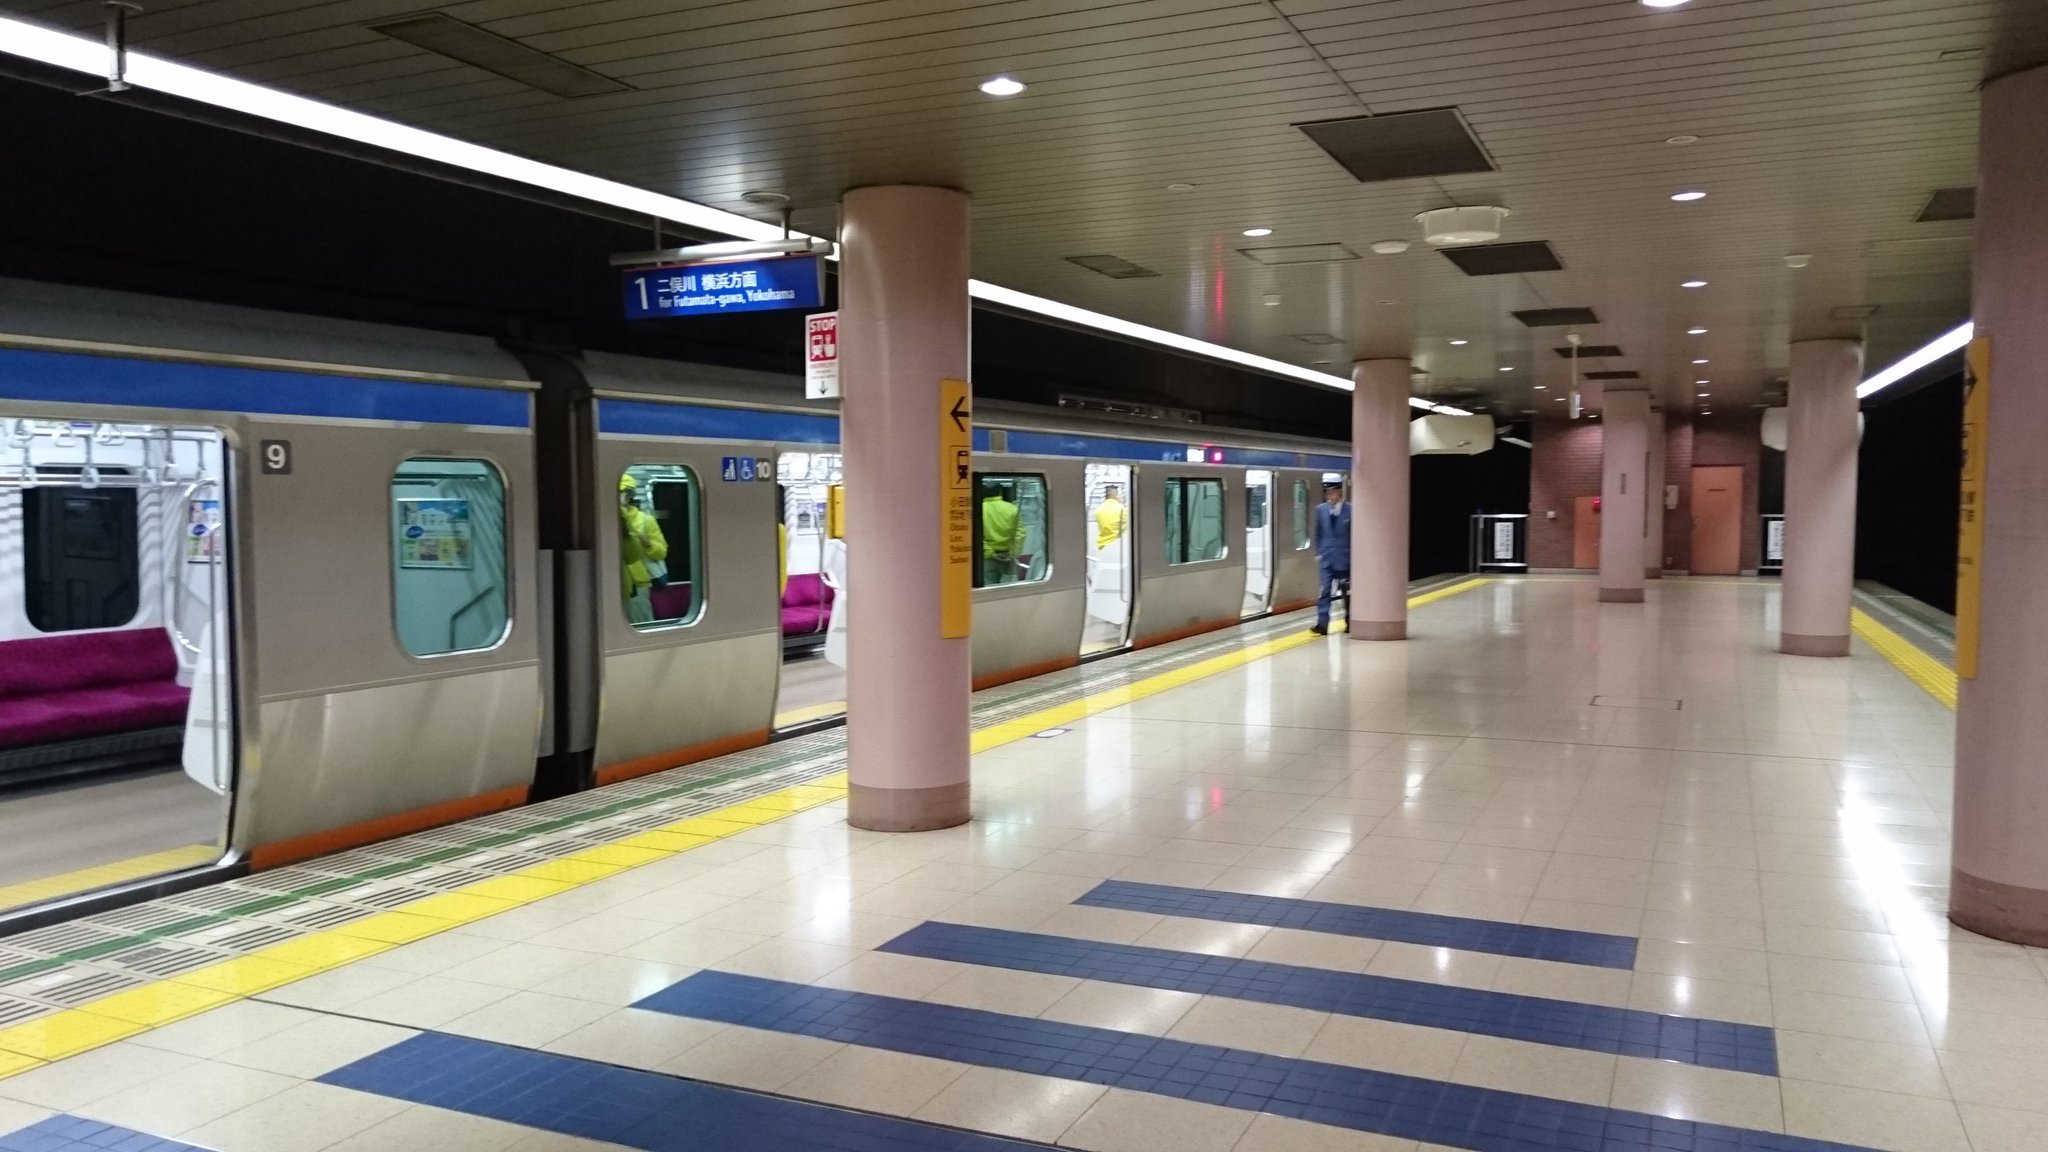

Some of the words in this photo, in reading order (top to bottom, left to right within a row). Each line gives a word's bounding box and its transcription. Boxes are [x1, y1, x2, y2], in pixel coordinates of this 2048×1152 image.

[657, 276, 697, 293] 二俣川
[701, 271, 757, 290] 横浜方面
[635, 277, 649, 309] 1
[659, 296, 673, 308] for
[747, 289, 795, 302] Yokohama
[810, 319, 836, 332] STOP
[266, 444, 286, 469] 9
[757, 462, 771, 478] 10
